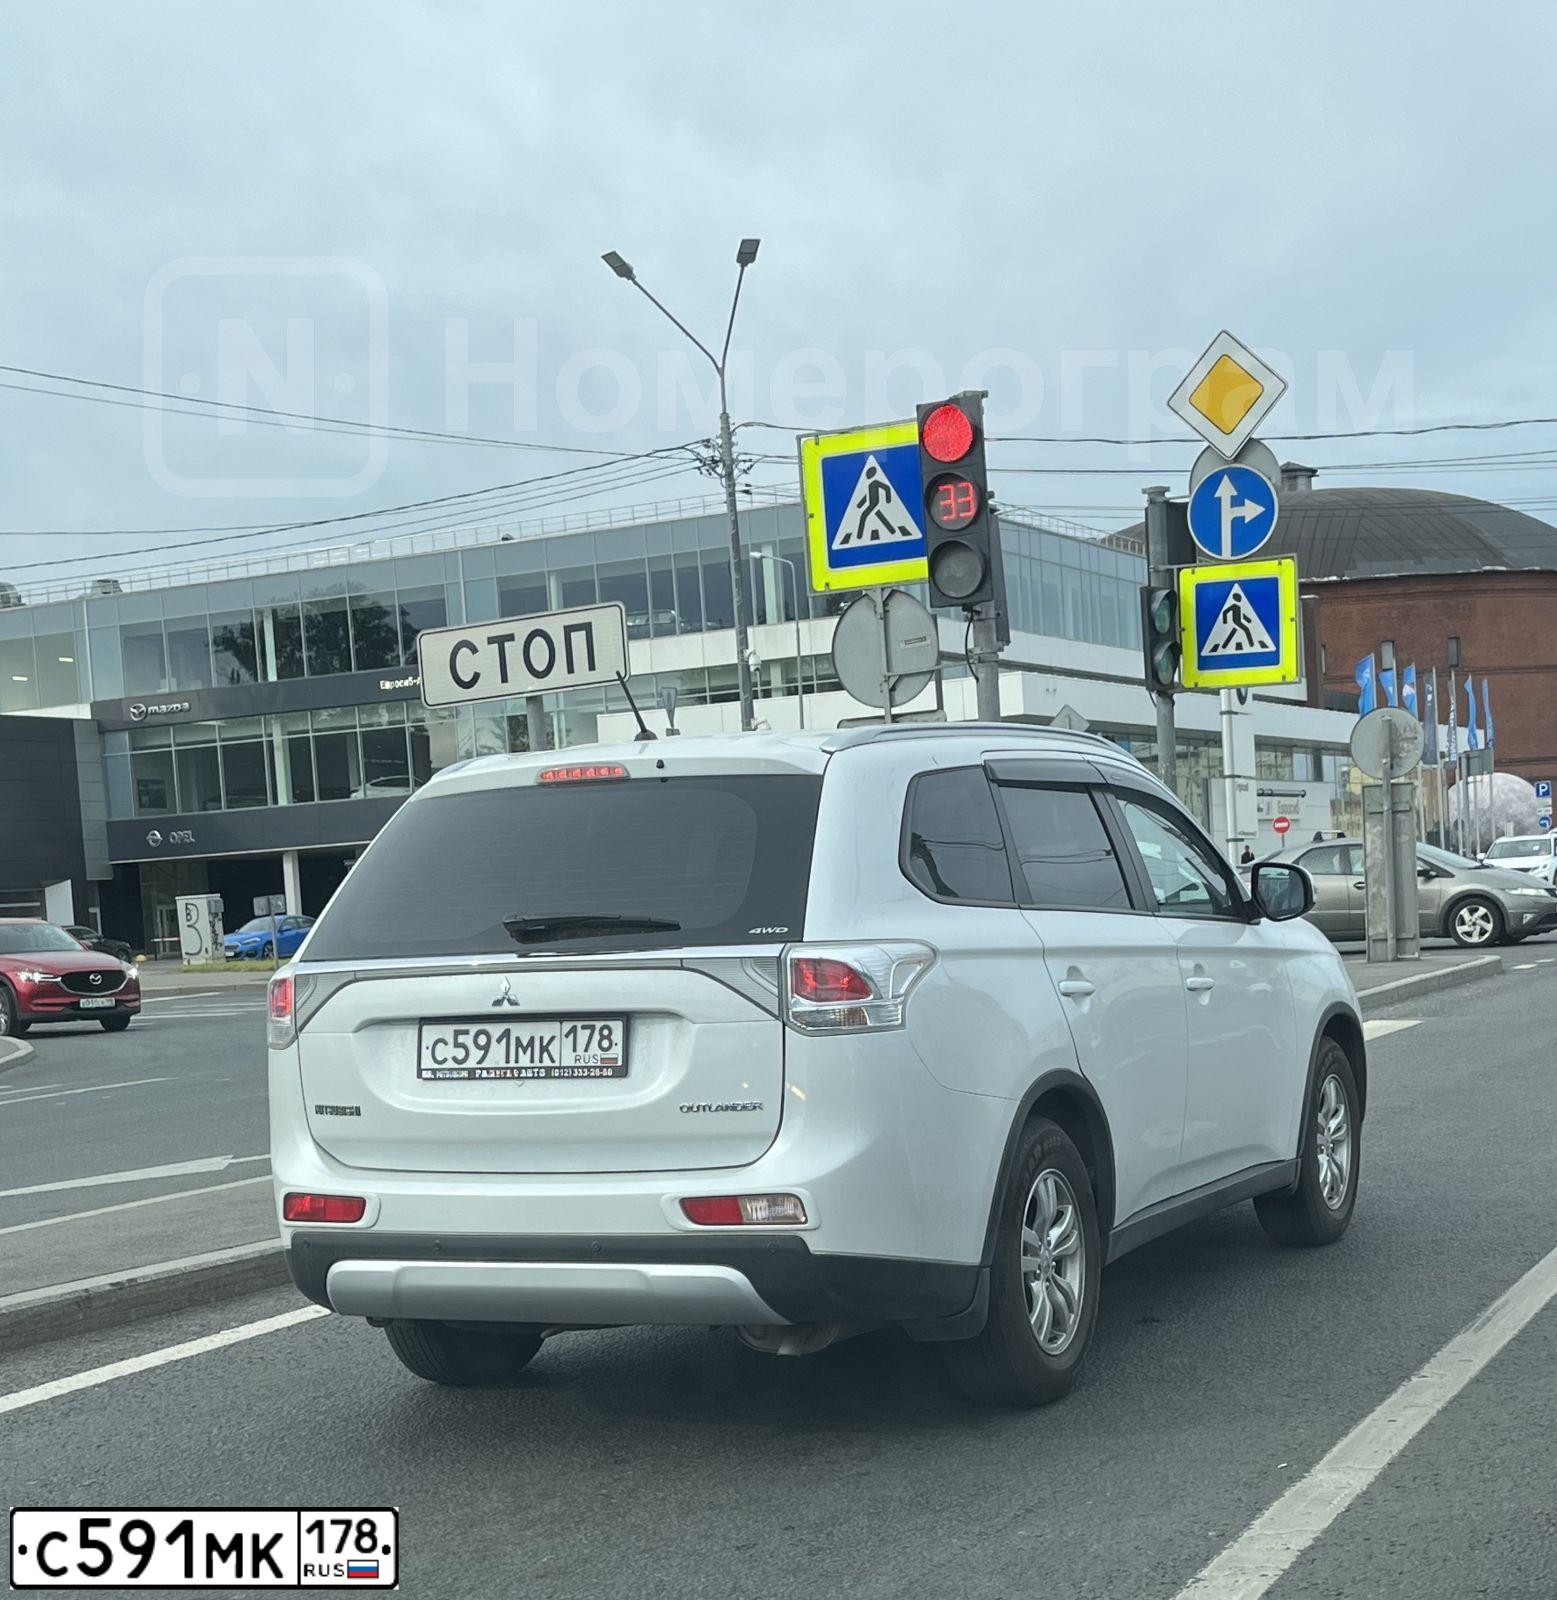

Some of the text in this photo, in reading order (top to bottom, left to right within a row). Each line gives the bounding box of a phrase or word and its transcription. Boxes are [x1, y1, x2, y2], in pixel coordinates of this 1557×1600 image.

[938, 482, 975, 520] 33
[449, 621, 596, 690] СТОП
[169, 830, 196, 844] OPEL
[564, 1024, 613, 1053] 178
[574, 1055, 599, 1065] RUS
[679, 1101, 764, 1114] OUTLANDER
